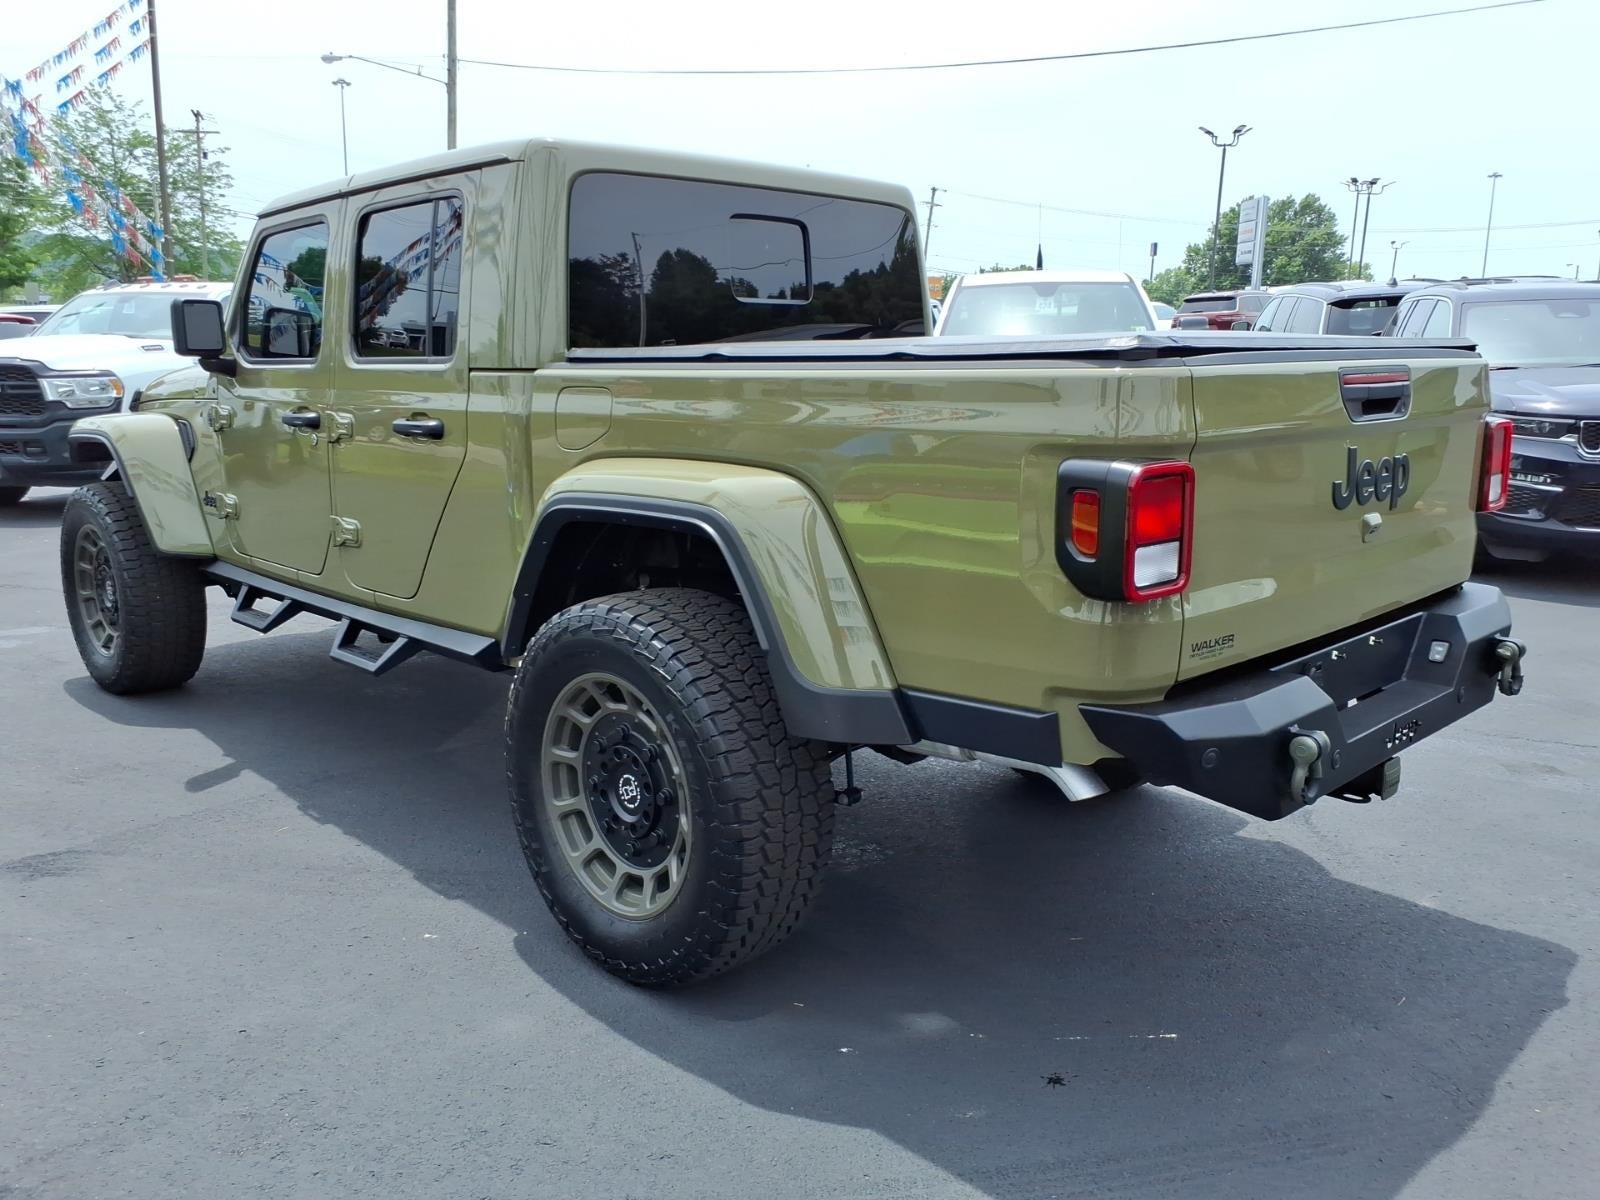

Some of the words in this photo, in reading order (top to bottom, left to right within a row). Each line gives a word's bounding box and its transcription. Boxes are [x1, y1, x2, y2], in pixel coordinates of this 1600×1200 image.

[1332, 445, 1410, 511] Jeep
[1191, 634, 1235, 653] WALKER
[1385, 720, 1420, 749] Jeep
